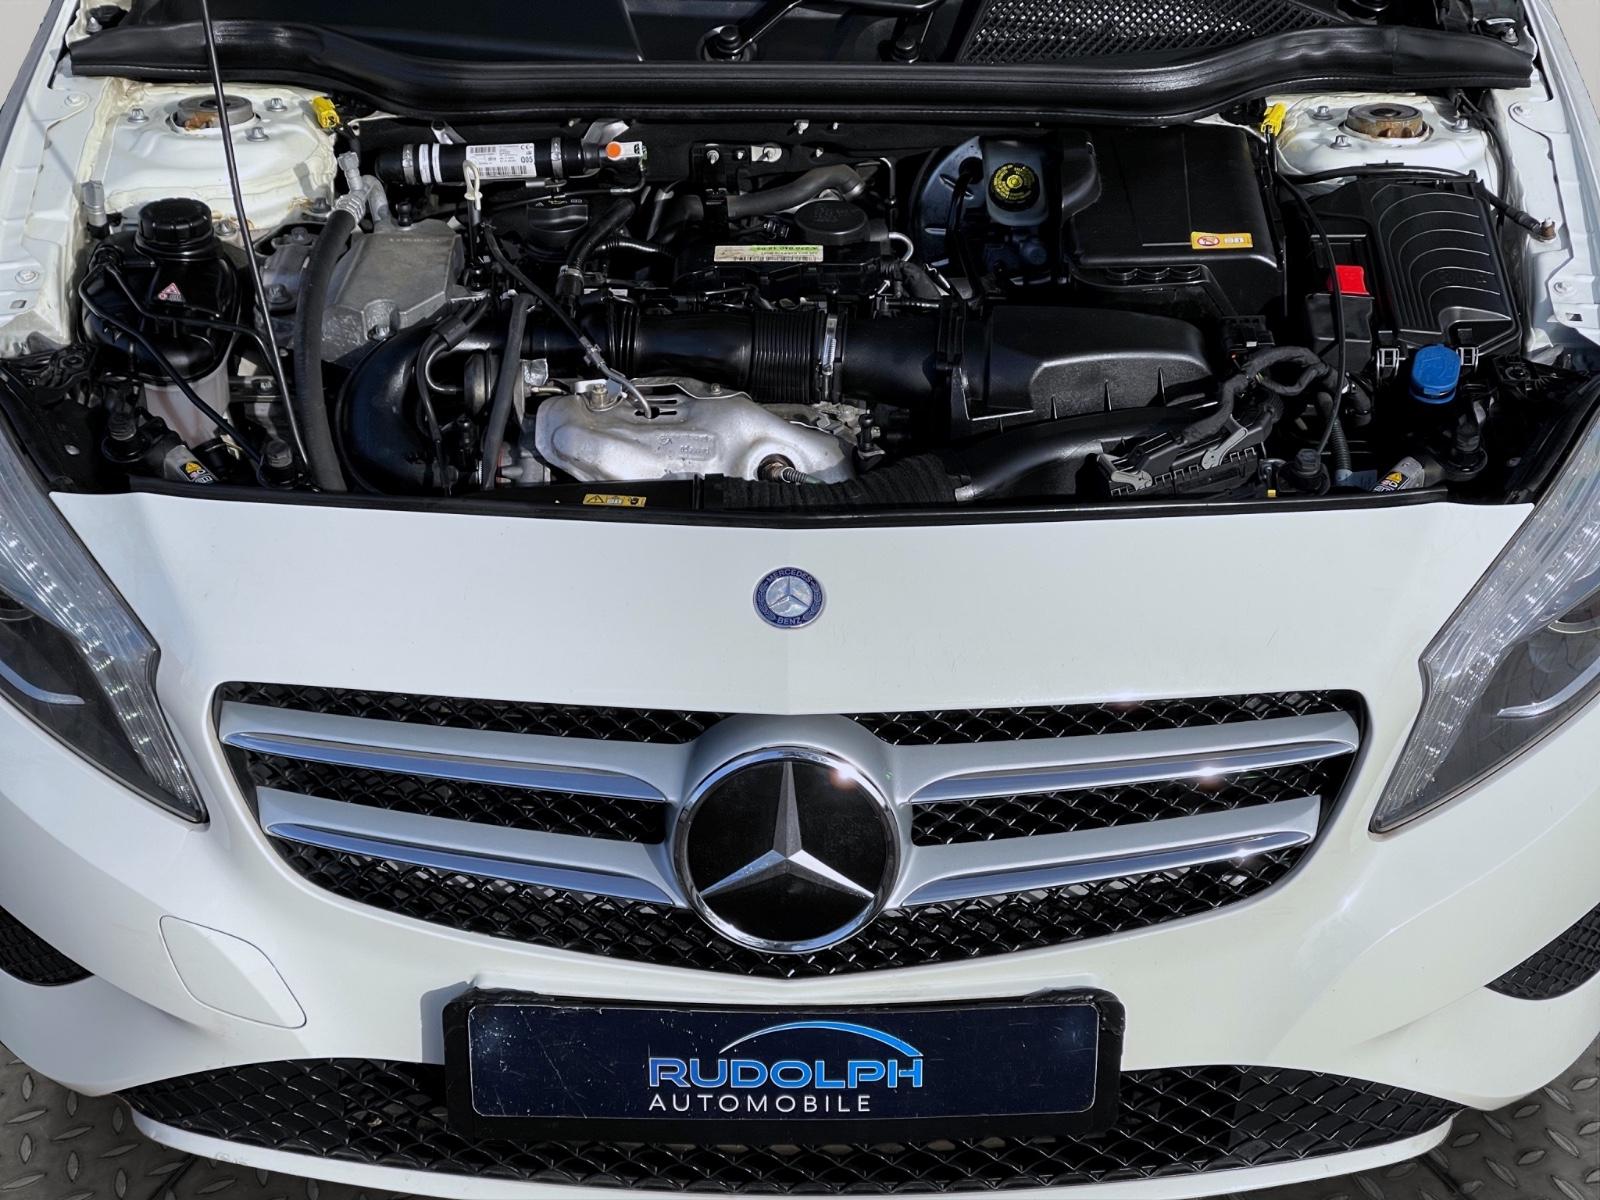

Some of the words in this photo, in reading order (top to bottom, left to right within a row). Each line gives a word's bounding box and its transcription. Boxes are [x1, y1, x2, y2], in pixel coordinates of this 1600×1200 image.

[766, 569, 813, 583] MERCEDES
[777, 617, 803, 625] BENZ
[649, 1058, 923, 1088] RUDOLPH
[649, 1094, 871, 1112] AUTOMOBILE
